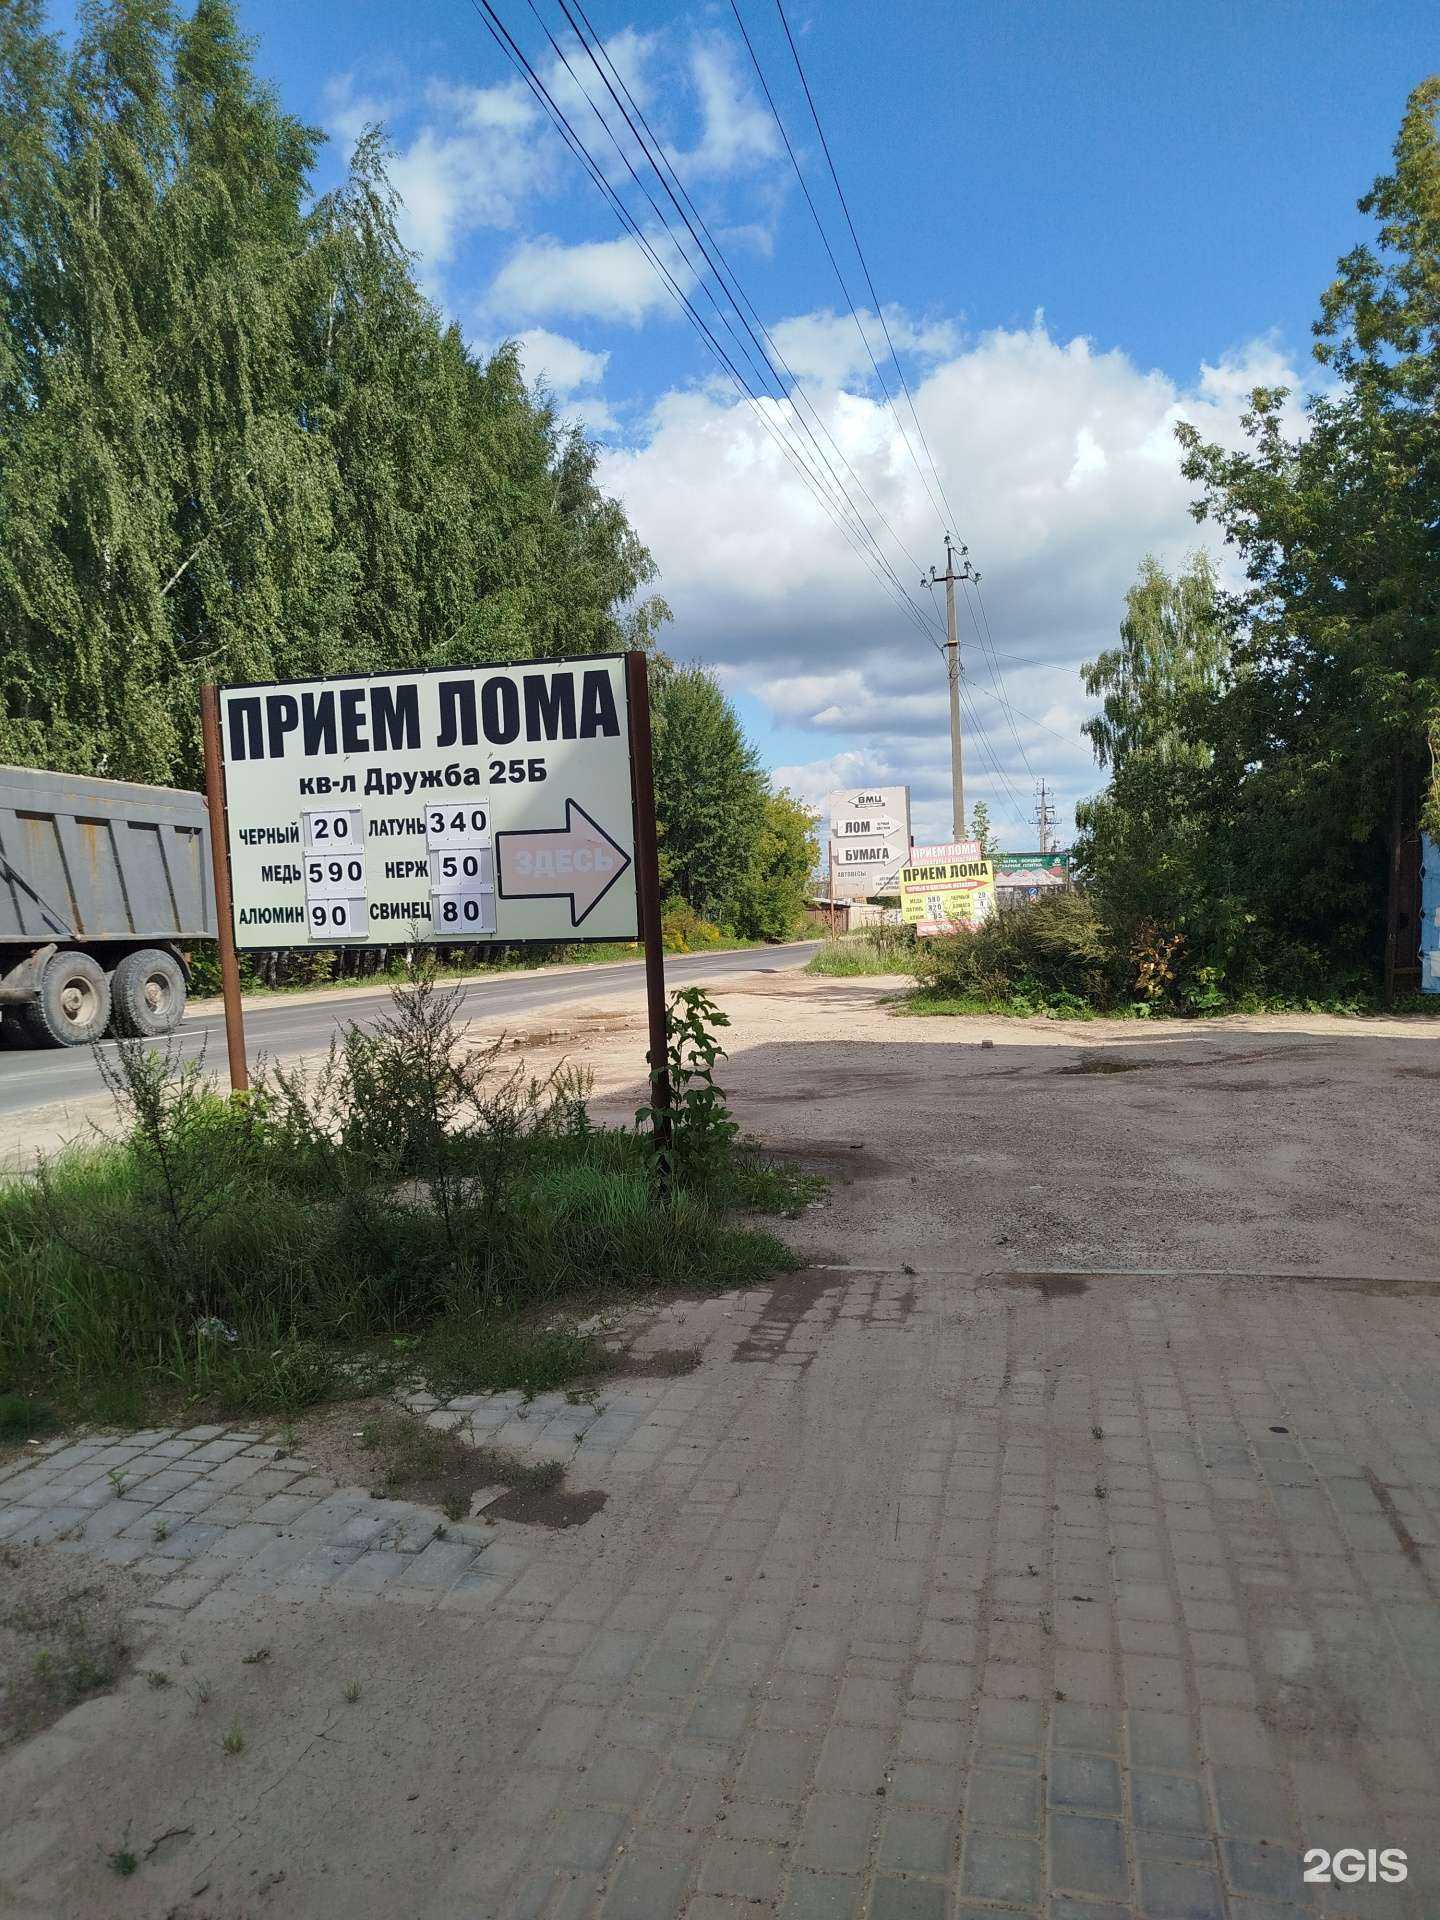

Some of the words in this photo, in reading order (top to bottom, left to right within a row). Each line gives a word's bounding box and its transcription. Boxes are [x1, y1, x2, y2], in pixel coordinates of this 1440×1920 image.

[227, 684, 421, 761] ПРИЕМ
[436, 669, 620, 748] ЛОМА
[299, 774, 357, 796] кв-л
[364, 763, 481, 796] Дружба
[489, 758, 548, 786] 25Б
[238, 821, 300, 846] ЧЕРНЫЙ
[313, 817, 349, 840] 20
[368, 815, 426, 837] ЛАТУНЬ
[430, 810, 488, 834] 340
[845, 821, 870, 833] ЛОМ
[512, 846, 616, 876] ЗДЕСЬ
[845, 848, 889, 861] БУМАГА
[913, 847, 946, 859] ПРИЕМ
[261, 864, 301, 882] МЕДЬ
[308, 860, 363, 883] 590
[384, 859, 429, 879] НЕРЖ
[442, 855, 479, 878] 50
[903, 866, 947, 882] ПРИЕМ
[950, 862, 988, 878] ЛОМА
[238, 905, 305, 925] АЛЮМИН
[311, 904, 347, 928] 90
[369, 901, 432, 922] СВИНЕЦ
[442, 899, 480, 922] 80
